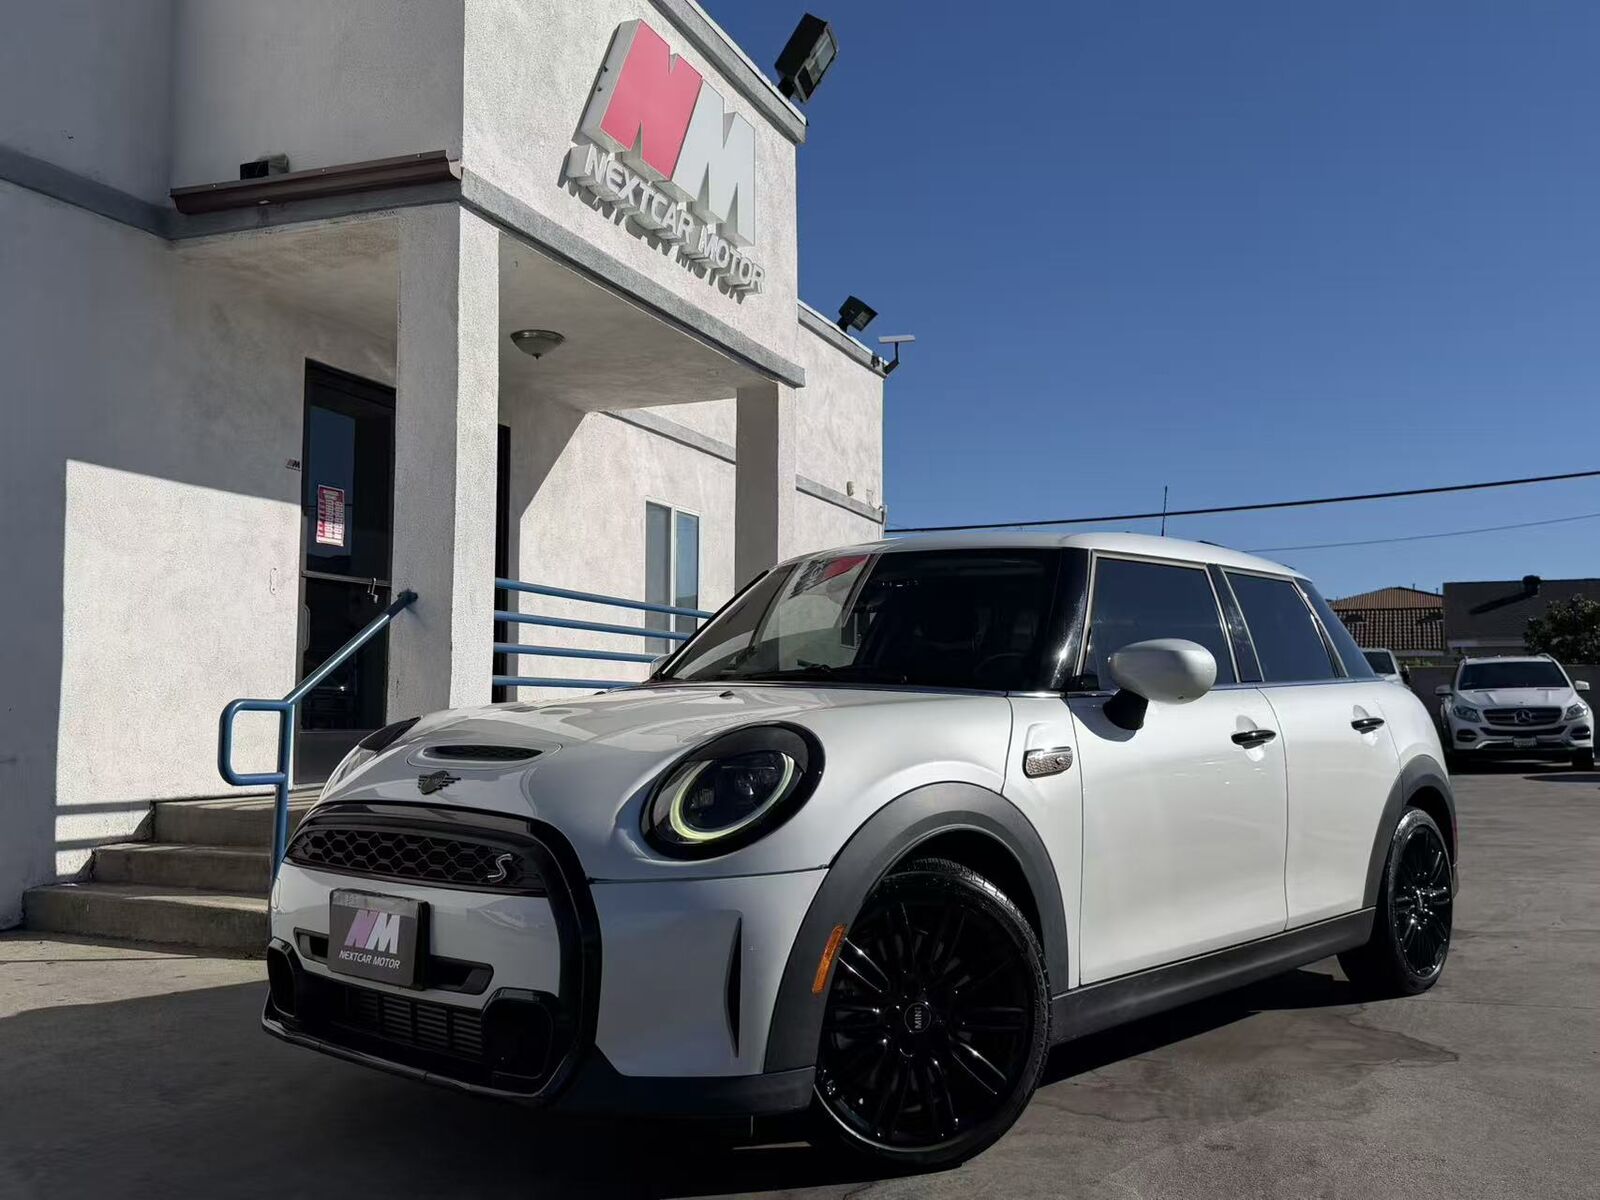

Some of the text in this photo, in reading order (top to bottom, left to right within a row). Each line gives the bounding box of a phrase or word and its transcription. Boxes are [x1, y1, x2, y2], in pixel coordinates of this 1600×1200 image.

[583, 143, 766, 296] NEXTCAR MOTOR
[487, 853, 513, 882] S
[339, 950, 401, 969] NEXTCAR MOTOR
[914, 1007, 922, 1029] MINI
